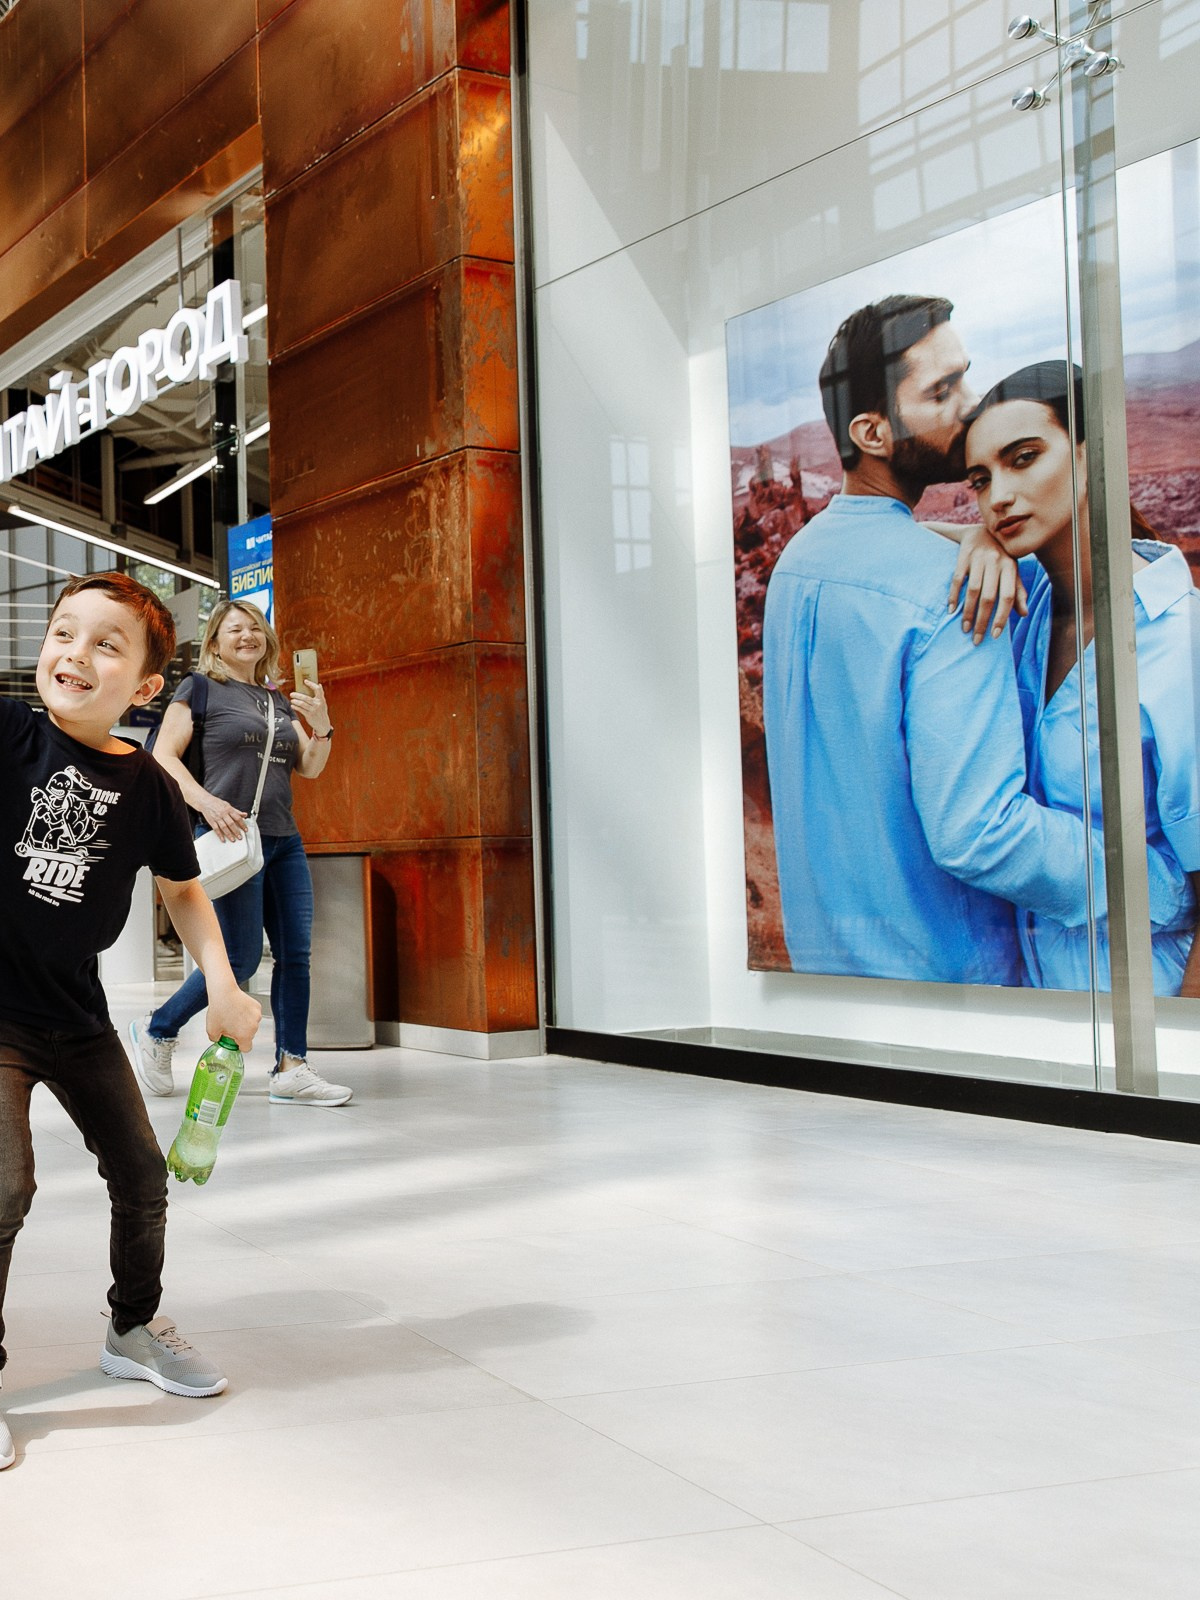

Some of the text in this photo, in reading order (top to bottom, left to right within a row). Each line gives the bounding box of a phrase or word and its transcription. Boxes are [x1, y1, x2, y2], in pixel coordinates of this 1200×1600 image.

[89, 787, 121, 805] TIME
[93, 801, 108, 816] to
[22, 857, 90, 888] RIDE
